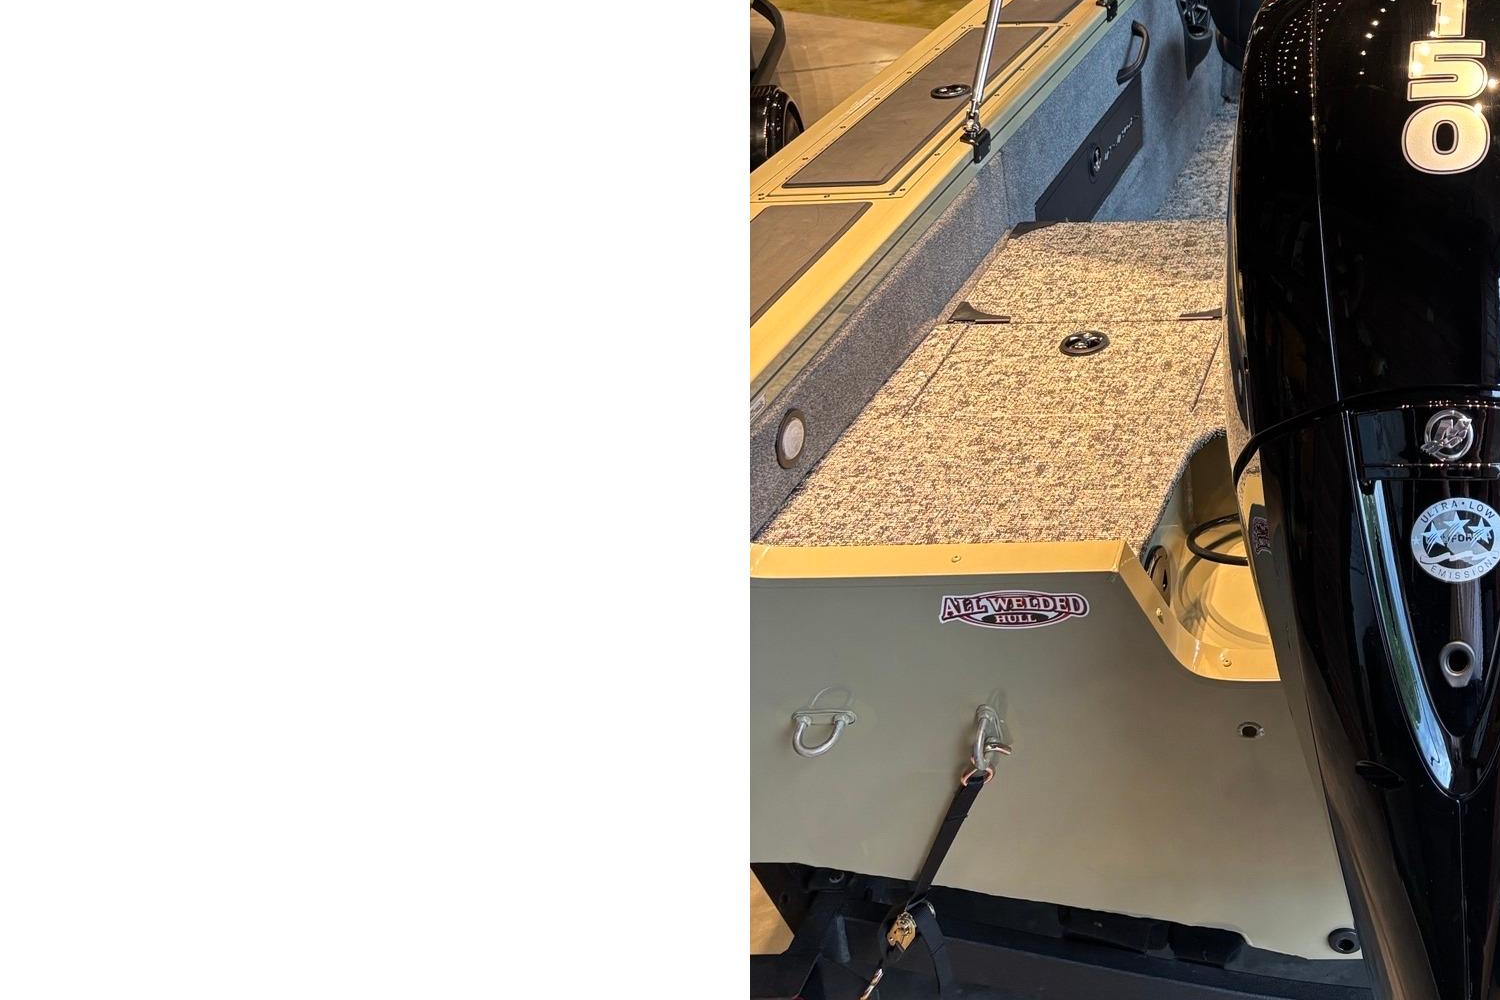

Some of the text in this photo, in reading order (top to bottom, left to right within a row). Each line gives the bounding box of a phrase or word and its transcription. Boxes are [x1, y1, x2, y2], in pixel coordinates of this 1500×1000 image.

[1420, 500, 1495, 525] ULTRA LOW
[1430, 559, 1494, 579] EMISSION
[943, 595, 1086, 619] ALL WELDED
[995, 614, 1037, 624] HULL
